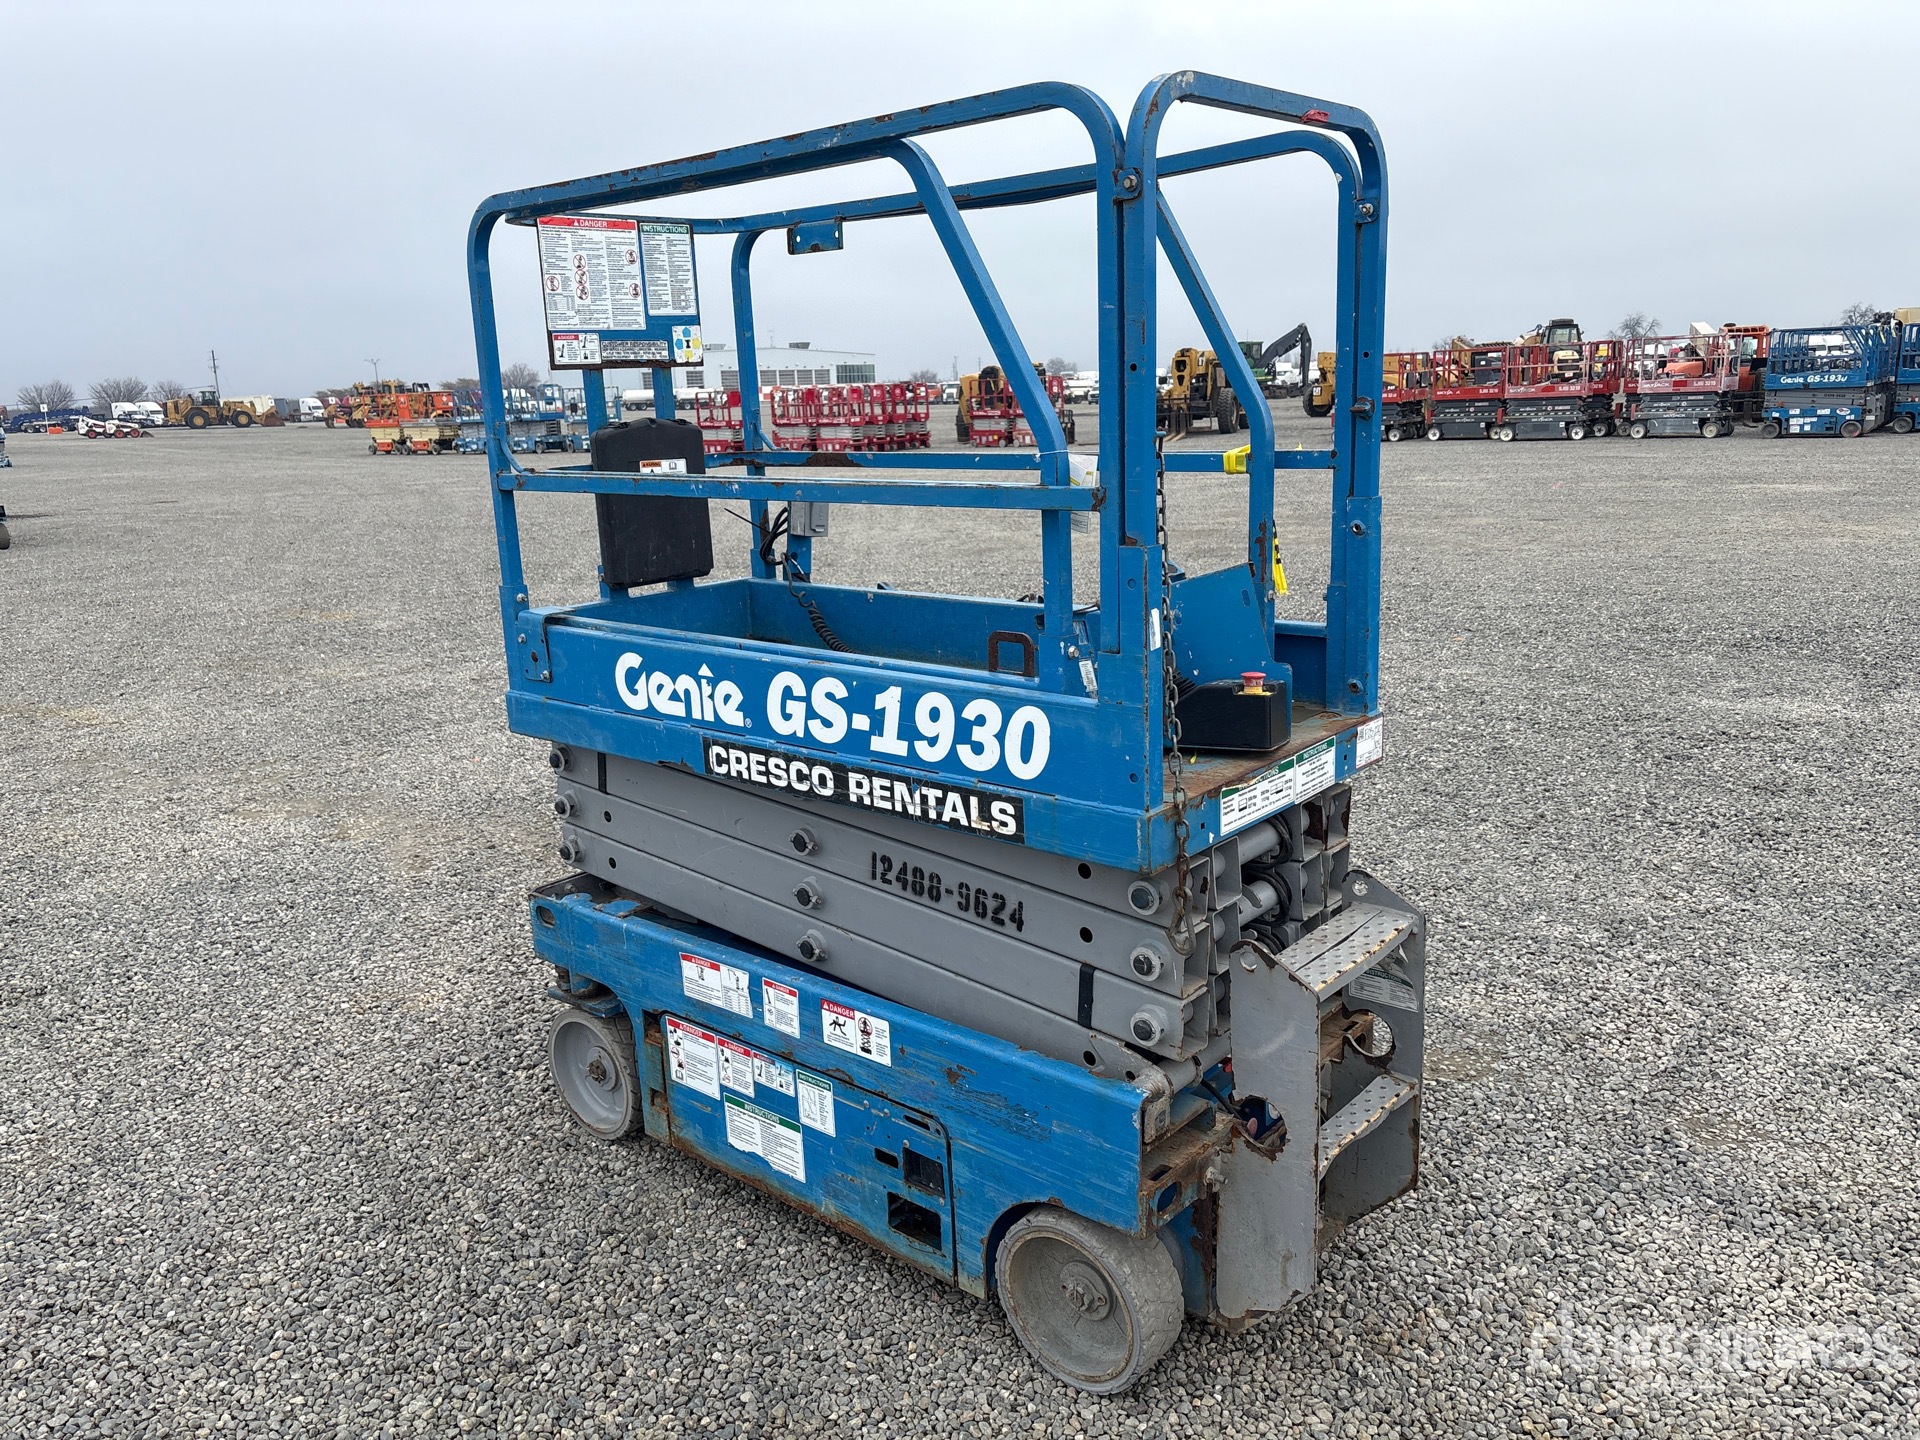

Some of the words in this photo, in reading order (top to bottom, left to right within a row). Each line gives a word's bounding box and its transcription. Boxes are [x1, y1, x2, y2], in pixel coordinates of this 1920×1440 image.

[642, 225, 688, 234] INSTRUCTIONS
[614, 652, 745, 727] Genie
[766, 671, 1050, 780] GS-1930
[1302, 742, 1328, 760] INSTRUCTIONS
[709, 745, 834, 797] CRESCO
[848, 771, 1016, 836] RENTALS
[870, 851, 1024, 932] 12488-9624
[696, 958, 711, 967] DANGER
[830, 1004, 854, 1018] DANGER
[682, 1024, 703, 1037] DANGER
[729, 1044, 745, 1054] DANGER
[800, 1074, 830, 1090] INSTRUCTIONS
[744, 1103, 780, 1123] INSTRUCTIONS
